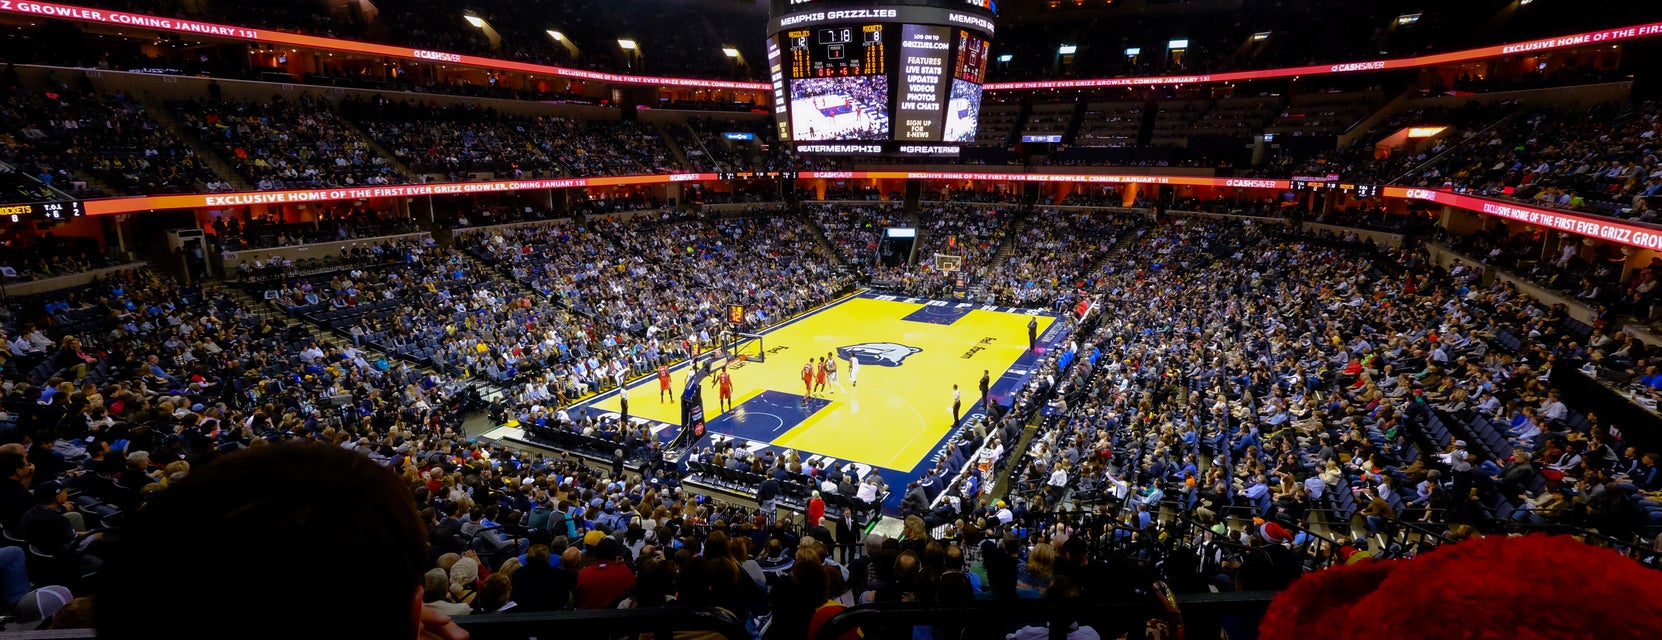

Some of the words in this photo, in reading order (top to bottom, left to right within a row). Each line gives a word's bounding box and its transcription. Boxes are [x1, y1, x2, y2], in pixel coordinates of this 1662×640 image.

[17, 2, 106, 21] GROWLER,
[110, 14, 170, 28] COMING
[174, 22, 236, 35] JANUARY
[239, 30, 258, 38] 15!
[781, 13, 825, 27] MEMPHIS
[828, 9, 897, 19] GRIZZLIES
[949, 13, 987, 27] MEMPHIS
[828, 29, 850, 42] 7:18
[873, 31, 880, 41] 8
[798, 37, 805, 46] 12
[902, 41, 949, 49] GRIZZLIES.COM
[1503, 40, 1555, 54] EXCLUSIVE
[1557, 35, 1590, 46] HOME
[1593, 32, 1609, 41] OF
[1611, 29, 1635, 39] THE
[907, 56, 942, 65] FEATURES
[905, 65, 920, 74] LIVE
[920, 66, 943, 75] STATS
[1339, 60, 1385, 71] CASHSAVER
[907, 75, 939, 84] UPDATES
[909, 84, 935, 92] VIDEOS
[906, 93, 936, 102] PHOTOS
[901, 102, 915, 110] LIVE
[916, 102, 940, 110] CHATS
[1090, 175, 1120, 183] COMING
[1121, 176, 1155, 184] JANUARY
[1233, 180, 1276, 189] CASHSAVER
[206, 194, 286, 206] EXCLUSIVE
[288, 191, 327, 202] HOME
[330, 190, 347, 199] OF
[350, 188, 372, 198] THE
[375, 186, 404, 197] FIRST
[407, 184, 431, 195] EVER
[434, 183, 461, 194] GRIZZ
[464, 181, 508, 192] GROWLER,
[510, 181, 540, 190] COMING
[541, 179, 575, 188] JANUARY
[73, 208, 80, 216] 2
[1484, 203, 1510, 216] EXCLUSIVE
[1511, 208, 1529, 221] HOME
[1530, 211, 1539, 223] OF
[1540, 213, 1554, 226] THE
[1554, 216, 1576, 230] FIRST
[1577, 221, 1600, 236] EVER
[1600, 226, 1630, 242] GRIZZ
